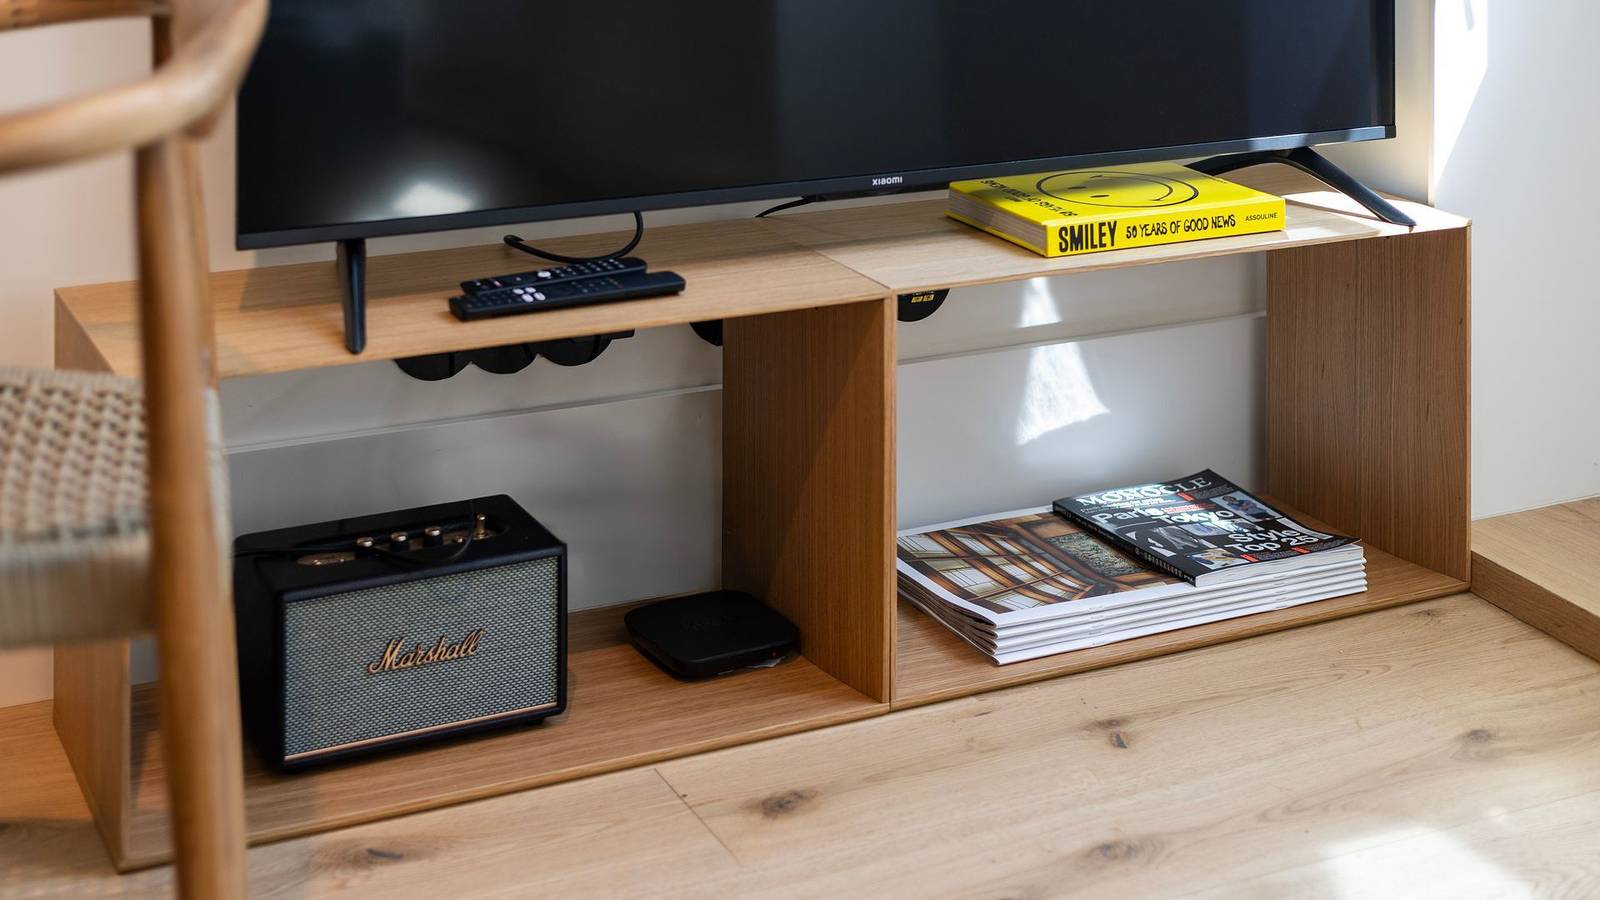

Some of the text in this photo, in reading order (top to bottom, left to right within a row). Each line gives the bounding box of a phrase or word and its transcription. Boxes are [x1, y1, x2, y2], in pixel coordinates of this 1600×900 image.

[1058, 212, 1278, 253] SMILEY 50 YEARS OF GOOD NEWS ASSOULINE
[1075, 477, 1212, 506] MONOCLE
[1091, 507, 1163, 525] Paris
[1151, 510, 1234, 527] Tokyo
[1224, 541, 1281, 552] Top
[1281, 535, 1319, 546] 25
[1228, 529, 1301, 543] Style
[368, 628, 486, 675] Marshall
